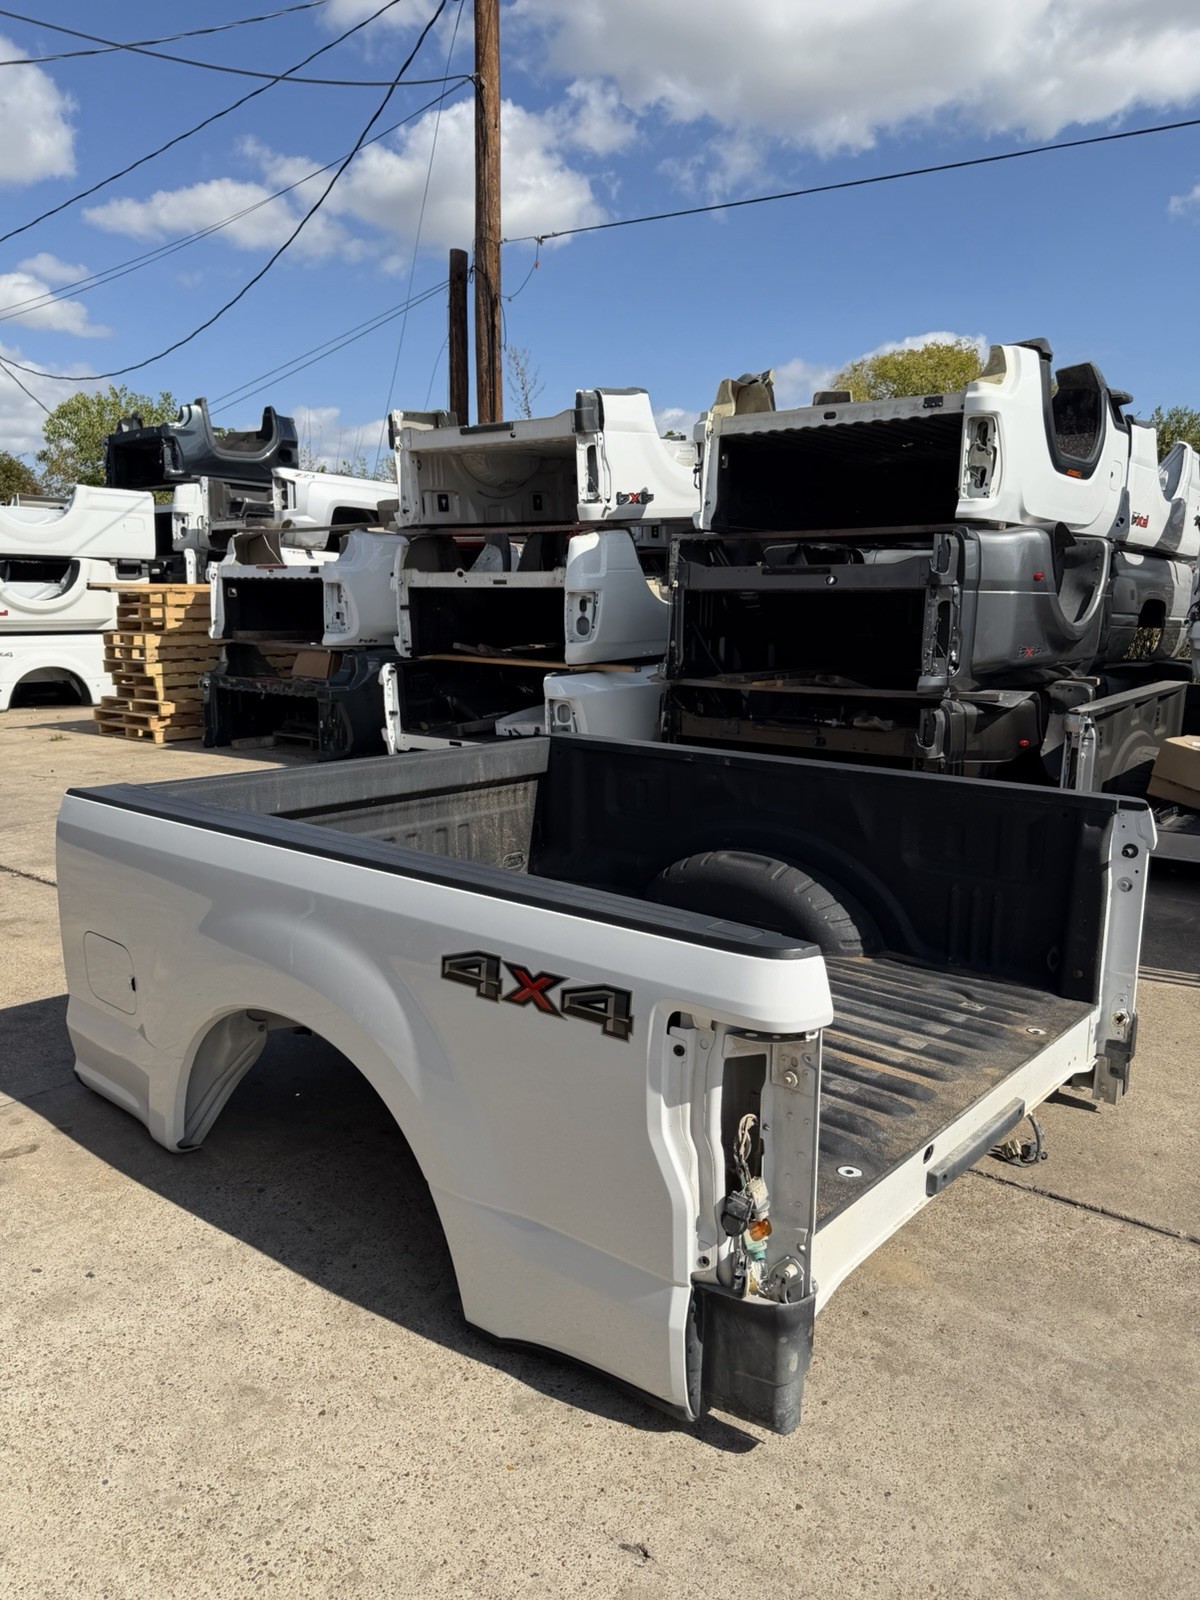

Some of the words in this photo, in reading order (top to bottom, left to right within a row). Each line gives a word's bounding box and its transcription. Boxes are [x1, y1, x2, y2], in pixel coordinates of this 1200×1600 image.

[616, 491, 654, 505] 4X4
[1017, 644, 1042, 659] 4X4
[441, 950, 634, 1043] 4X4
